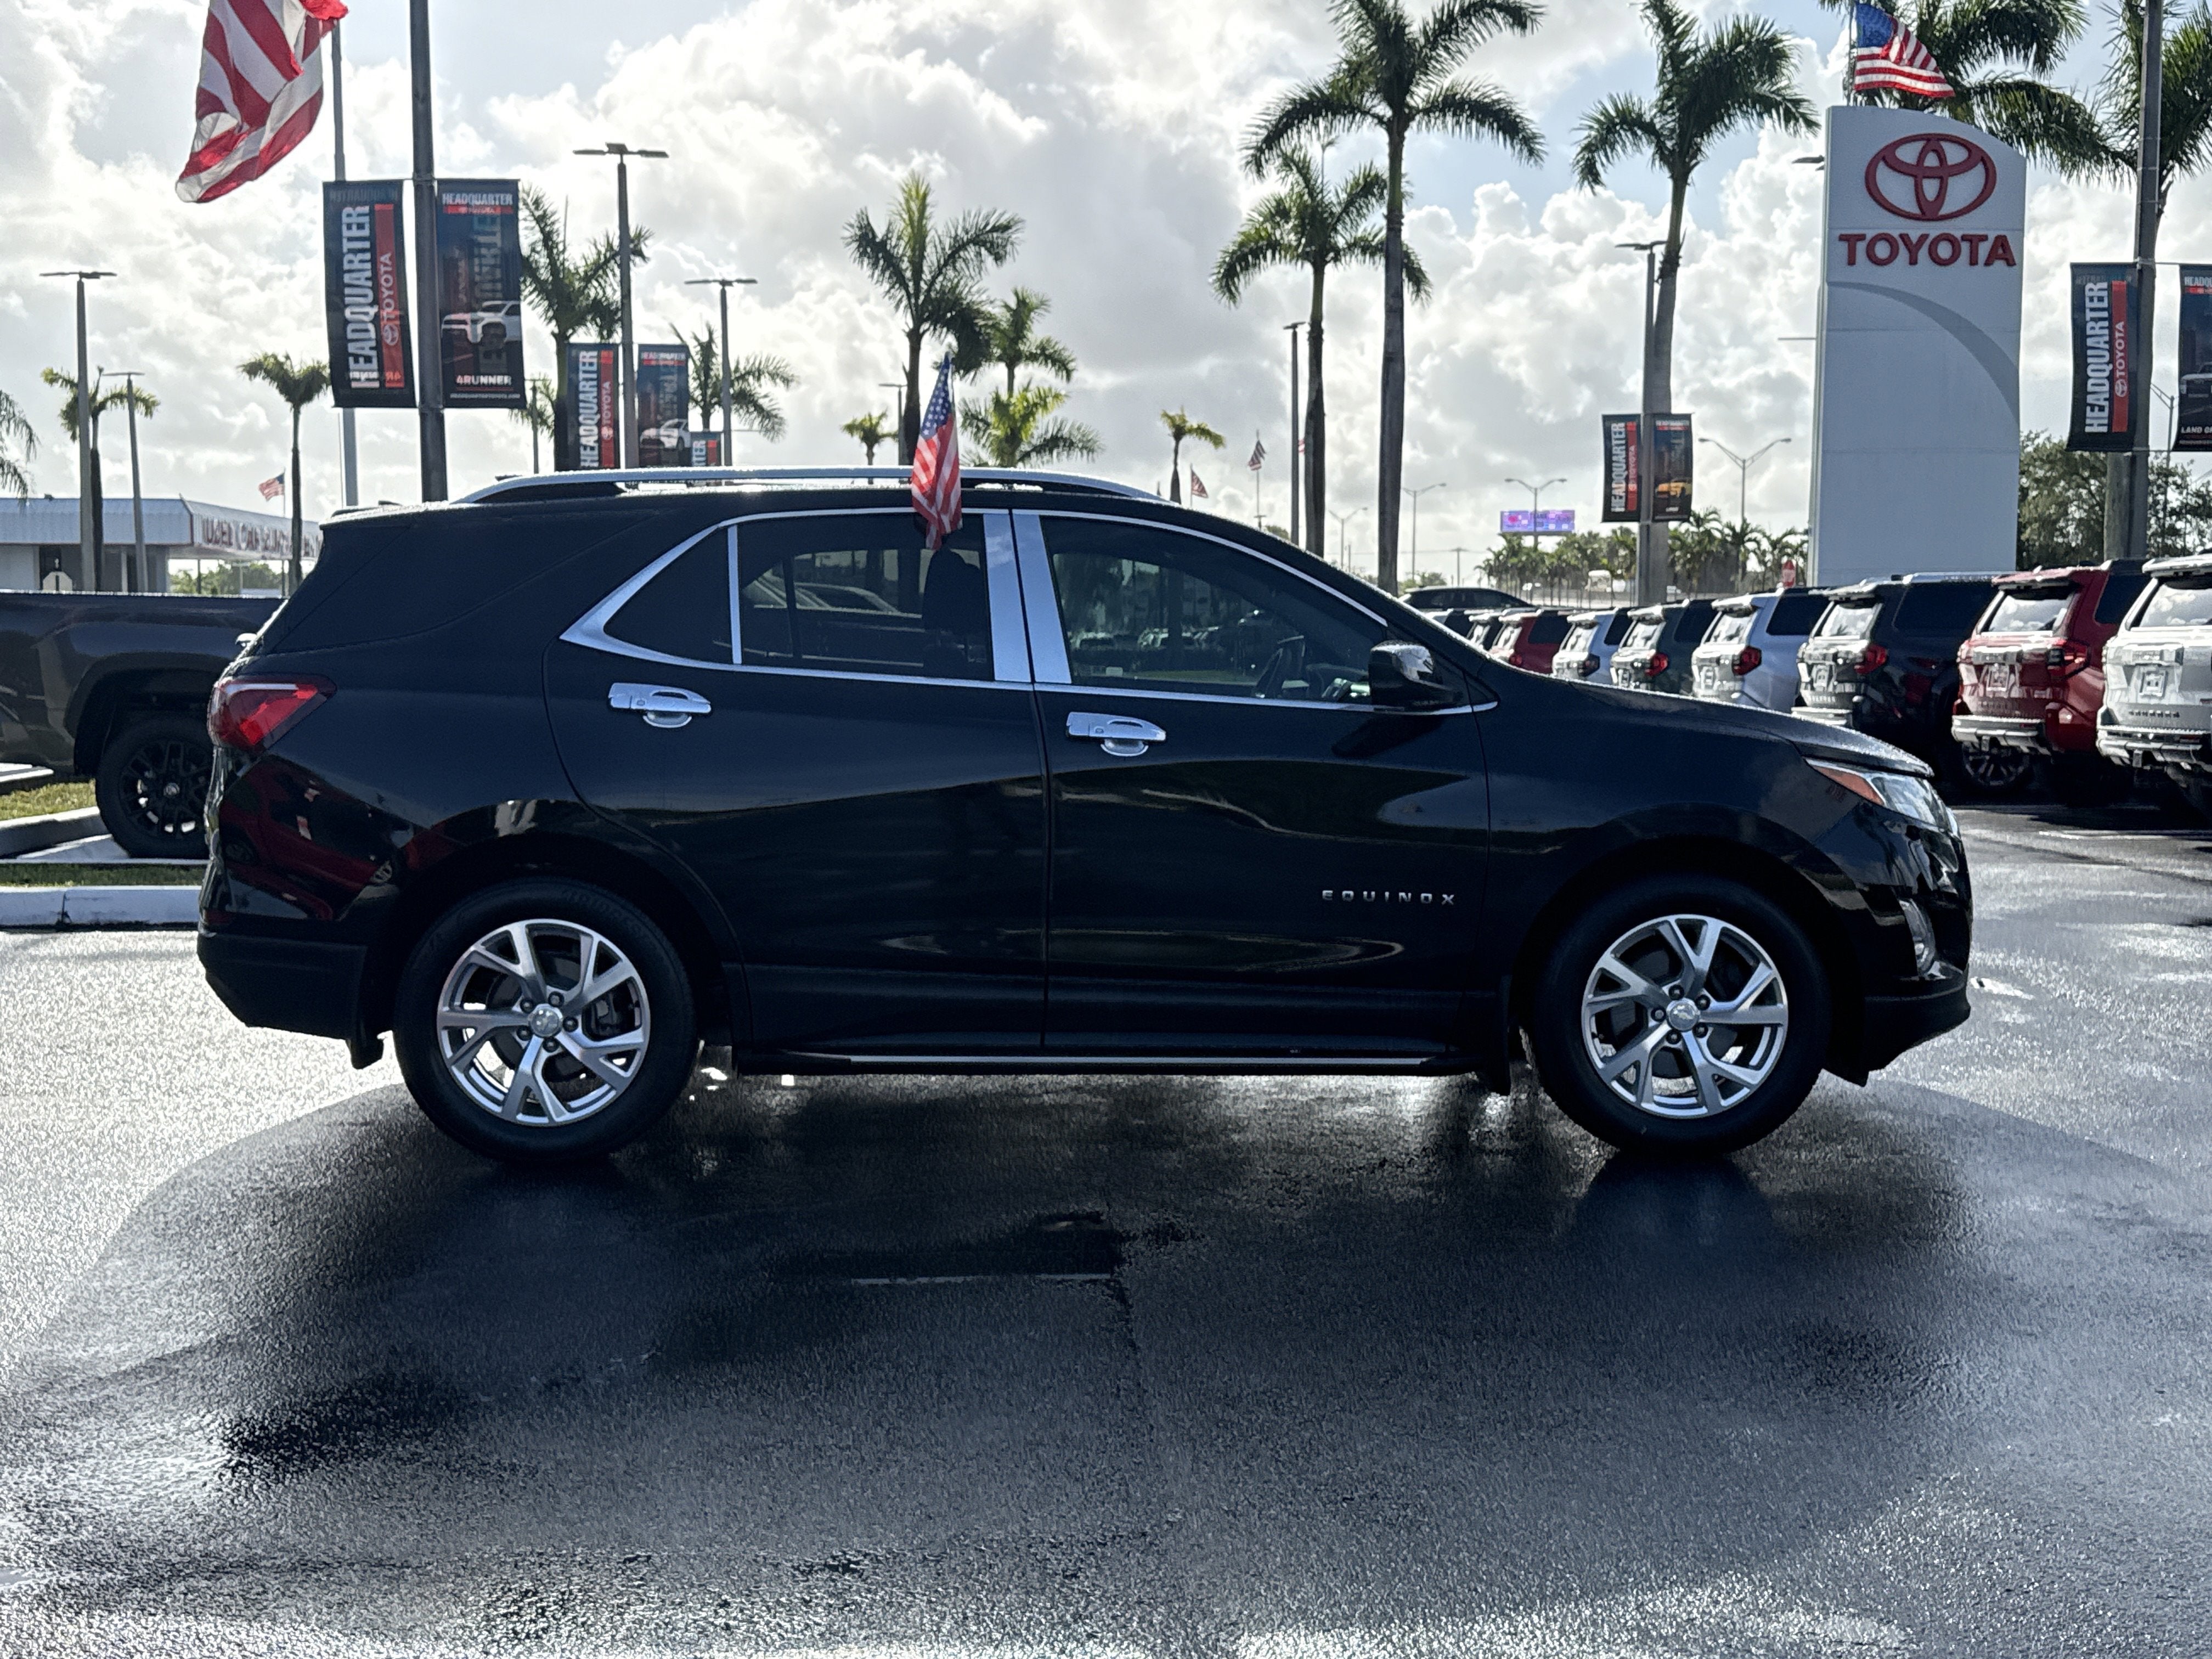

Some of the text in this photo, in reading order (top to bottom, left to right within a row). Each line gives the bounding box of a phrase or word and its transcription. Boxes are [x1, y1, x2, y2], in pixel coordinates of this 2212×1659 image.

[1838, 233, 2016, 267] TOYOTA
[341, 205, 380, 388] HEADQUARTER
[380, 252, 396, 321] TOYOTA
[2085, 281, 2113, 433] HEADQUARTER
[2115, 321, 2126, 377] TOYOTA
[456, 375, 512, 385] 4RUNNER
[602, 381, 611, 423] TOYOTA
[579, 351, 601, 467] HEADQUARTER
[1322, 890, 1455, 905] EQUINOX
